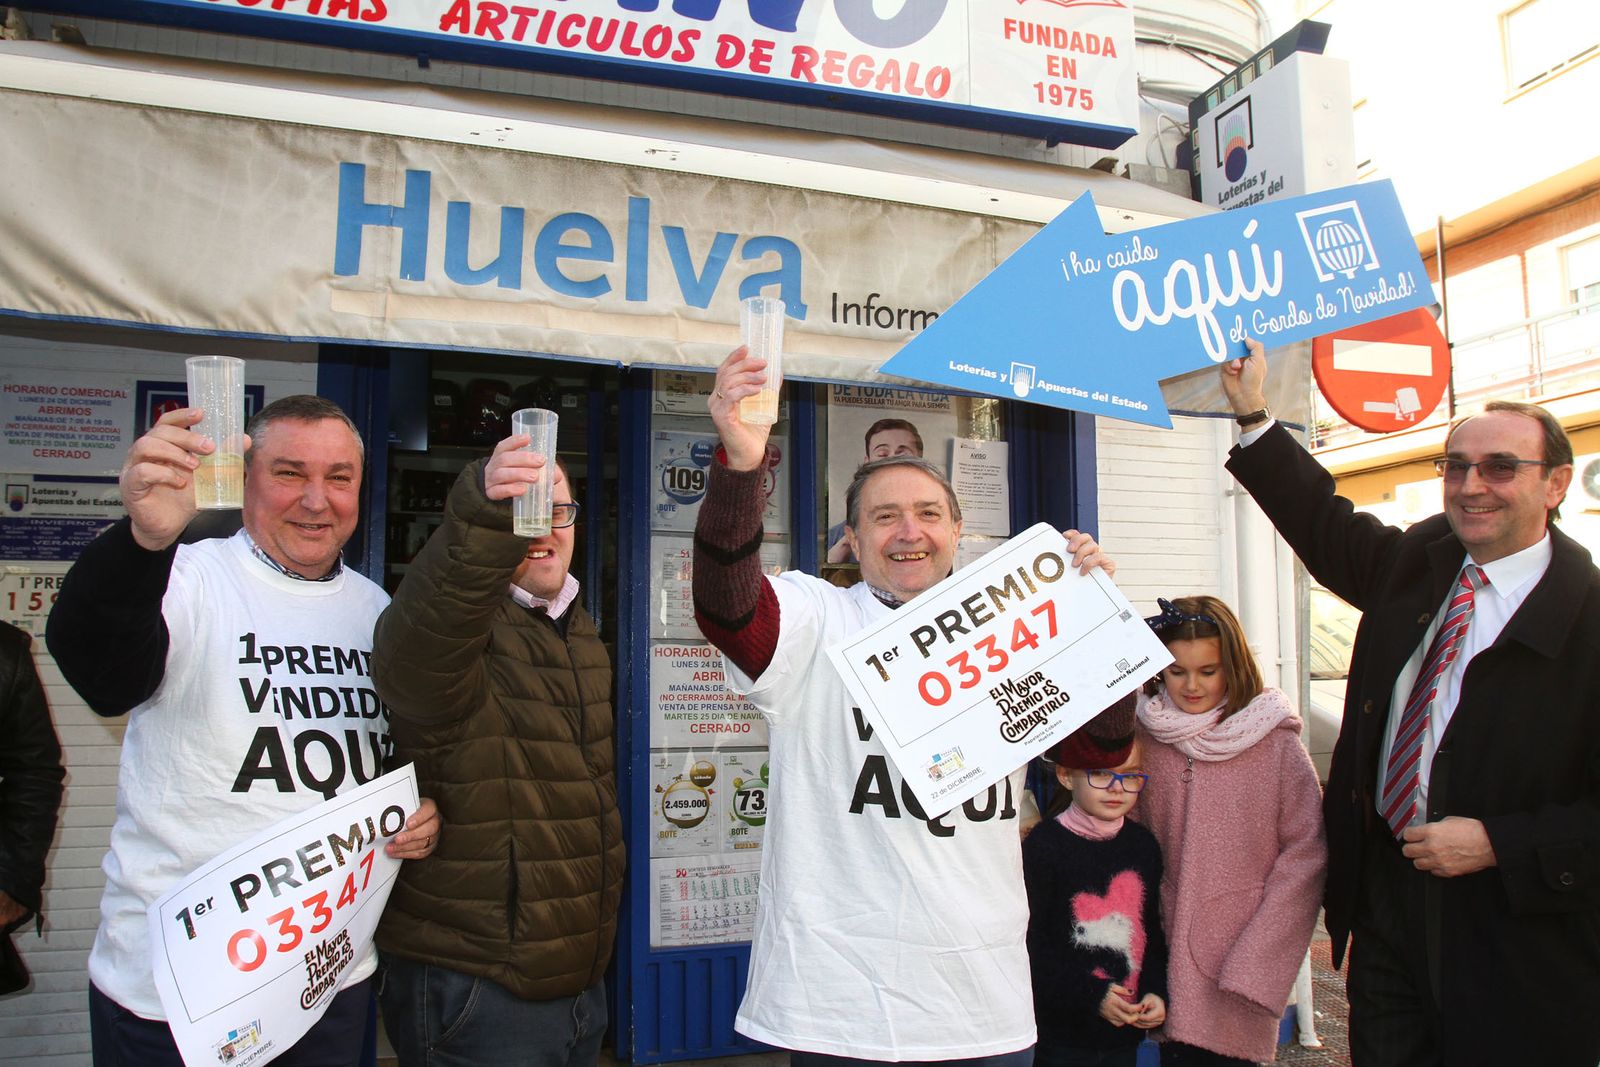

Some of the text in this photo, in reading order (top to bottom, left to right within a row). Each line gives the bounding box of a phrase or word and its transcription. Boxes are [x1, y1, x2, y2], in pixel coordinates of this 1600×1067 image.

[439, 0, 701, 63] ARTICULOS
[715, 34, 775, 75] DE
[790, 45, 951, 99] REGALO
[1004, 18, 1118, 58] FUNDADA
[1046, 54, 1078, 80] EN
[1033, 81, 1094, 111] 1975
[1260, 169, 1267, 185] y
[1268, 175, 1284, 196] del
[333, 161, 808, 321] Huelva
[1112, 218, 1283, 363] aquí
[831, 292, 940, 331] Inform
[1229, 271, 1417, 342] el Gordo de Navidad!
[4, 384, 128, 399] HORARIO COMERCIAL
[1000, 371, 1008, 383] y
[1037, 379, 1089, 402] Apuestas
[1091, 390, 1109, 403] del
[1111, 394, 1149, 412] Estado
[38, 405, 92, 416] ABRIMOS
[22, 423, 67, 431] CERRAMOS
[33, 448, 92, 459] CERRADO
[81, 441, 116, 449] NAVIDAD
[666, 466, 706, 491] 109
[31, 498, 74, 506] Apuestas
[865, 551, 1066, 683] 1er PREMIO
[654, 647, 711, 658] HORARIO
[917, 599, 1059, 707] 03347
[1125, 656, 1150, 676] Nacional
[660, 694, 675, 702] (NO
[989, 686, 1004, 701] EL
[1042, 679, 1060, 697] ES
[659, 703, 686, 711] VENTA
[687, 703, 699, 711] DE
[700, 703, 734, 711] PRENSA
[735, 703, 742, 711] Y
[1000, 691, 1071, 743] COMPARTIRLO
[690, 723, 751, 734] CERRADO
[930, 766, 983, 799] 22 de DICIEMBRE
[665, 799, 708, 810] 2.459.000
[175, 804, 406, 940] 1er PREMIO
[226, 848, 375, 973] 03347
[304, 949, 317, 966] EL
[300, 948, 354, 1011] COMPARTIRLO
